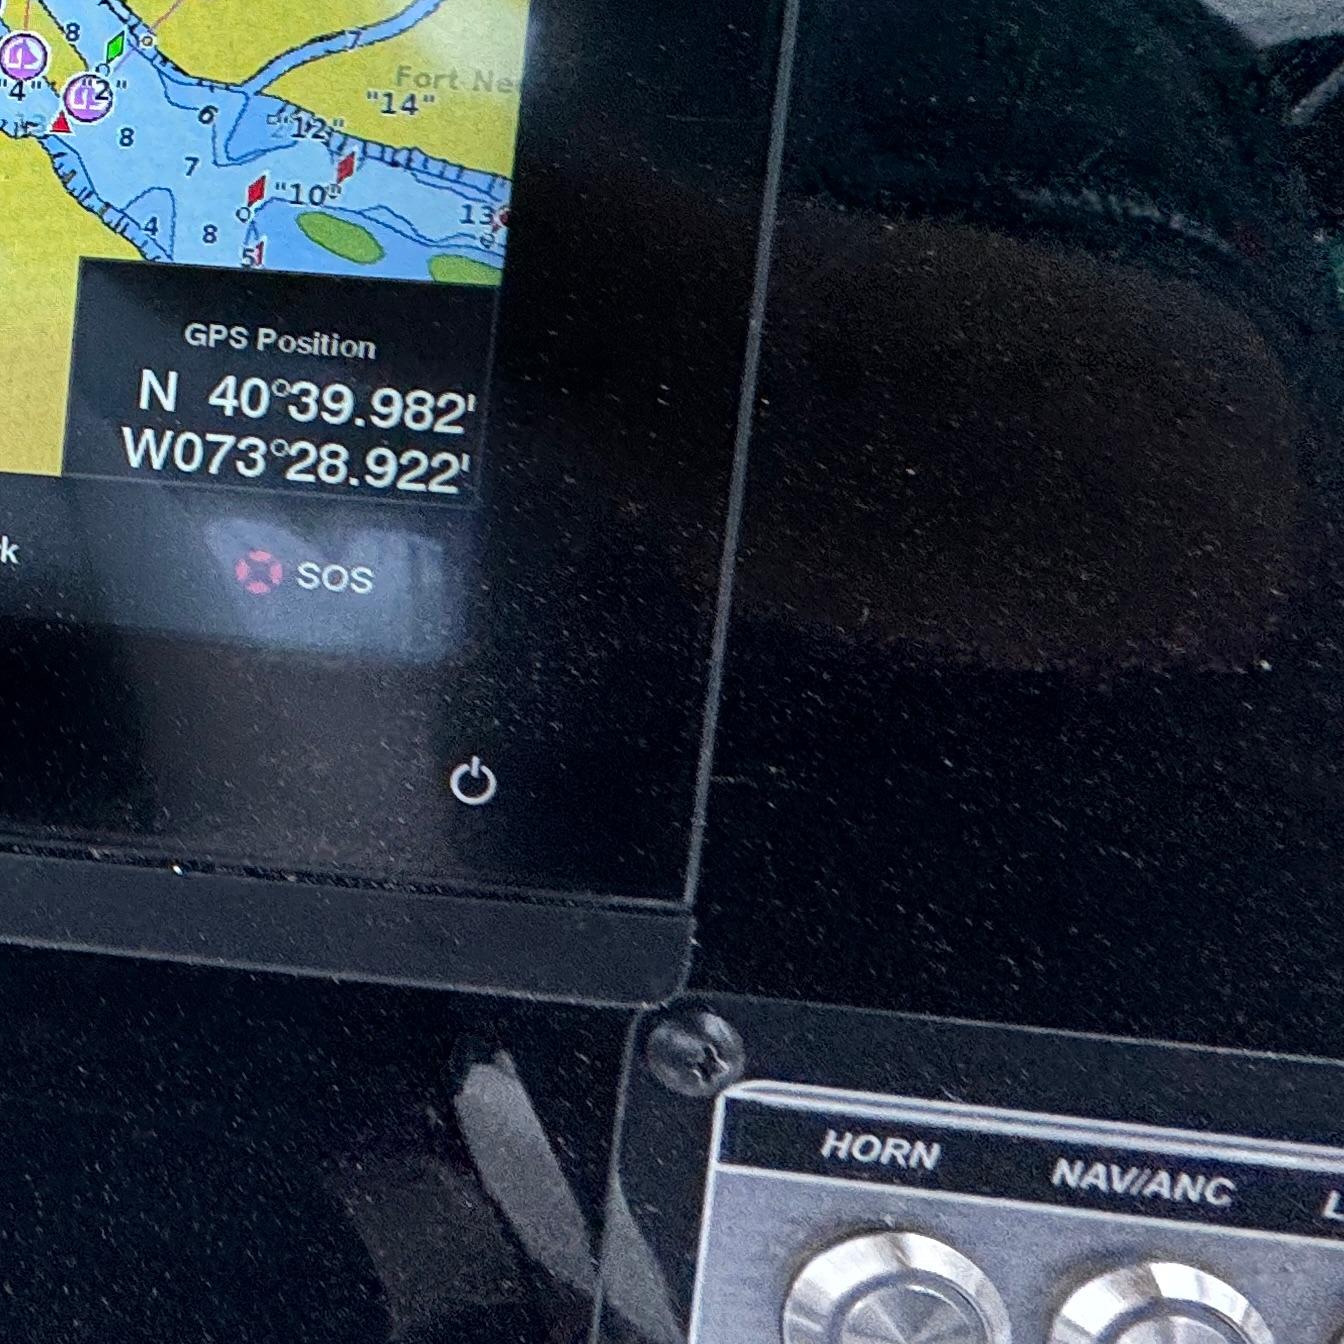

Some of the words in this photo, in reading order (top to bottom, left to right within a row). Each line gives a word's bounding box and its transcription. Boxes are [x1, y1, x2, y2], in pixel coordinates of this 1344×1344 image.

[66, 23, 81, 42] 8
[396, 64, 459, 91] Fort
[198, 105, 219, 125] 6
[120, 128, 135, 148] 8
[184, 157, 200, 177] 7
[144, 216, 159, 236] 4
[460, 203, 495, 226] 13
[202, 224, 218, 244] 8
[184, 322, 249, 350] GPS
[257, 327, 376, 360] Position
[138, 368, 180, 413] N
[296, 562, 374, 595] SOS
[821, 1128, 942, 1171] HORN
[1050, 1157, 1236, 1208] NAV/ANC
